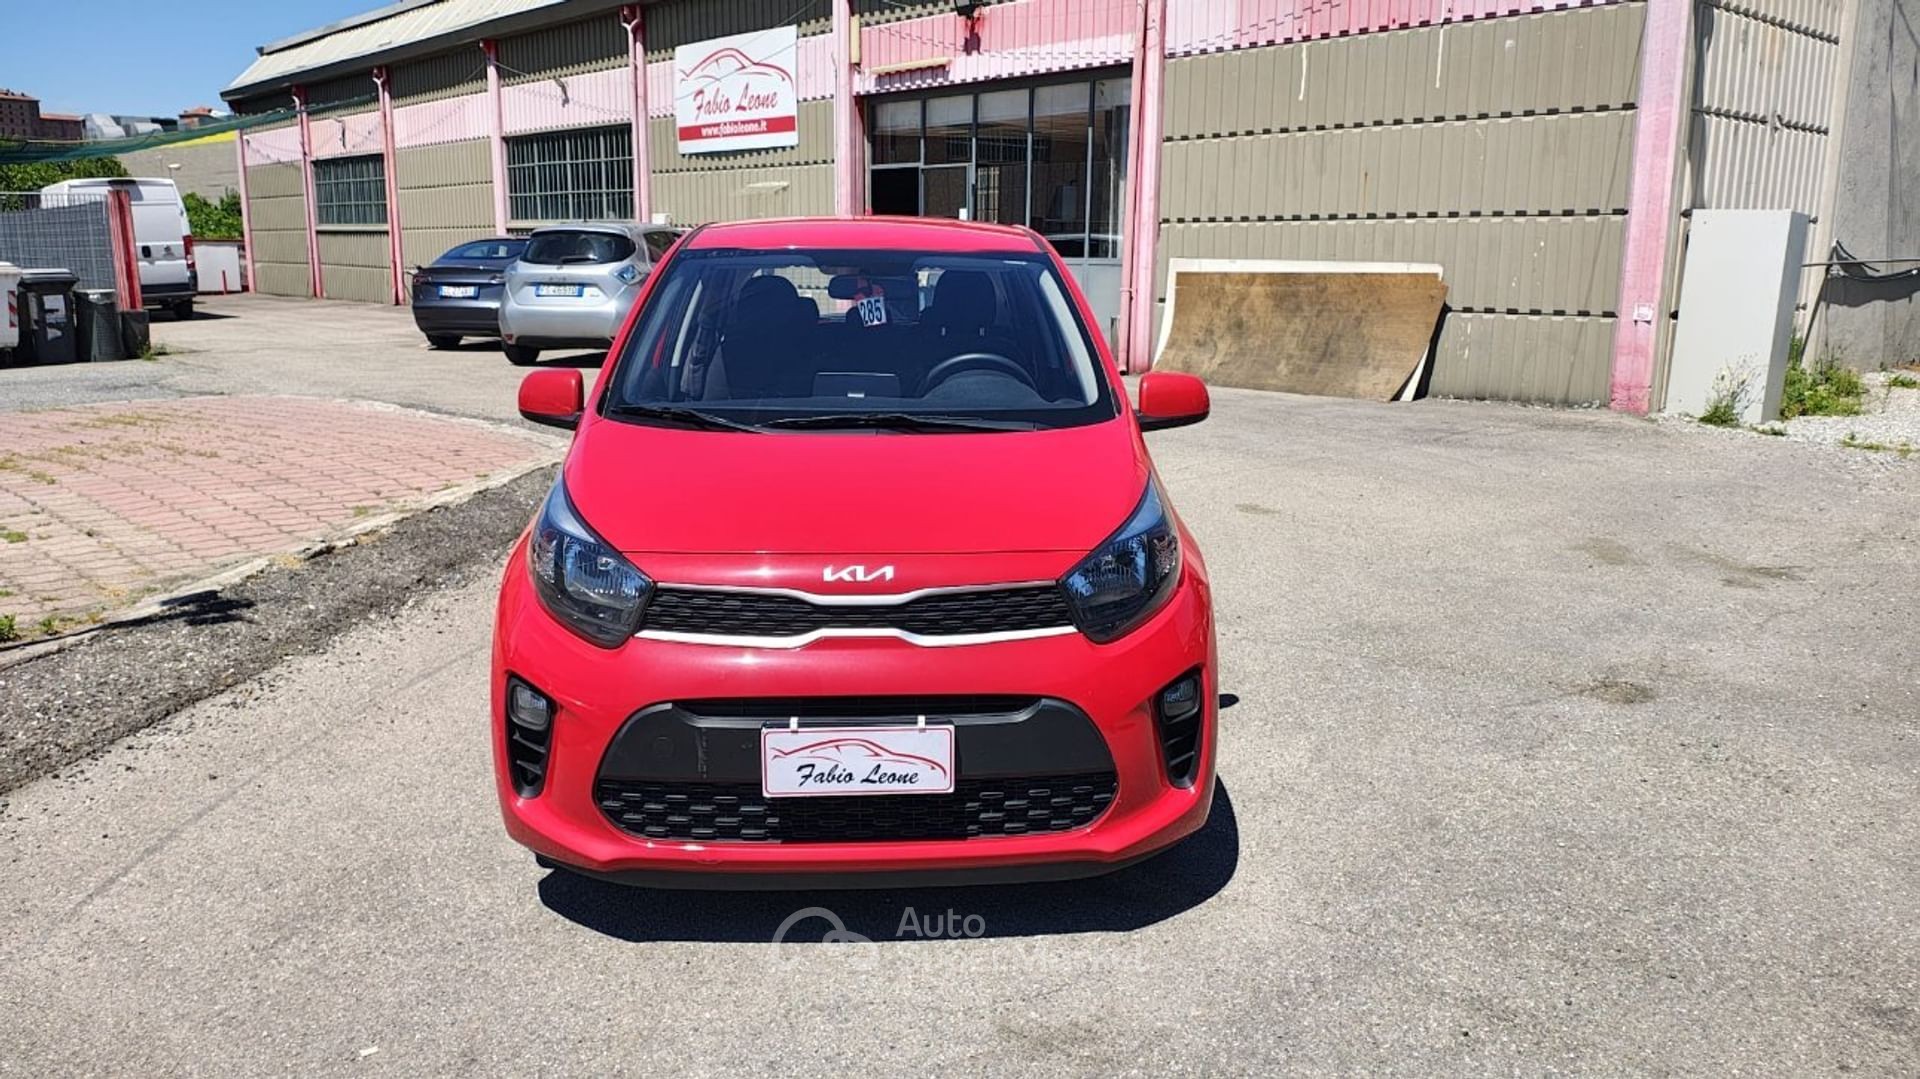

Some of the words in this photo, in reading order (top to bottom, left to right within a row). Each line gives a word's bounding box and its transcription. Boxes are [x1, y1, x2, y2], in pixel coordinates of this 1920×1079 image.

[693, 87, 731, 121] Fabio
[735, 82, 778, 112] Leone
[701, 119, 768, 138] www.fabioleone.it
[859, 298, 883, 325] 285
[796, 763, 855, 787] Fabio
[861, 762, 920, 786] Leone
